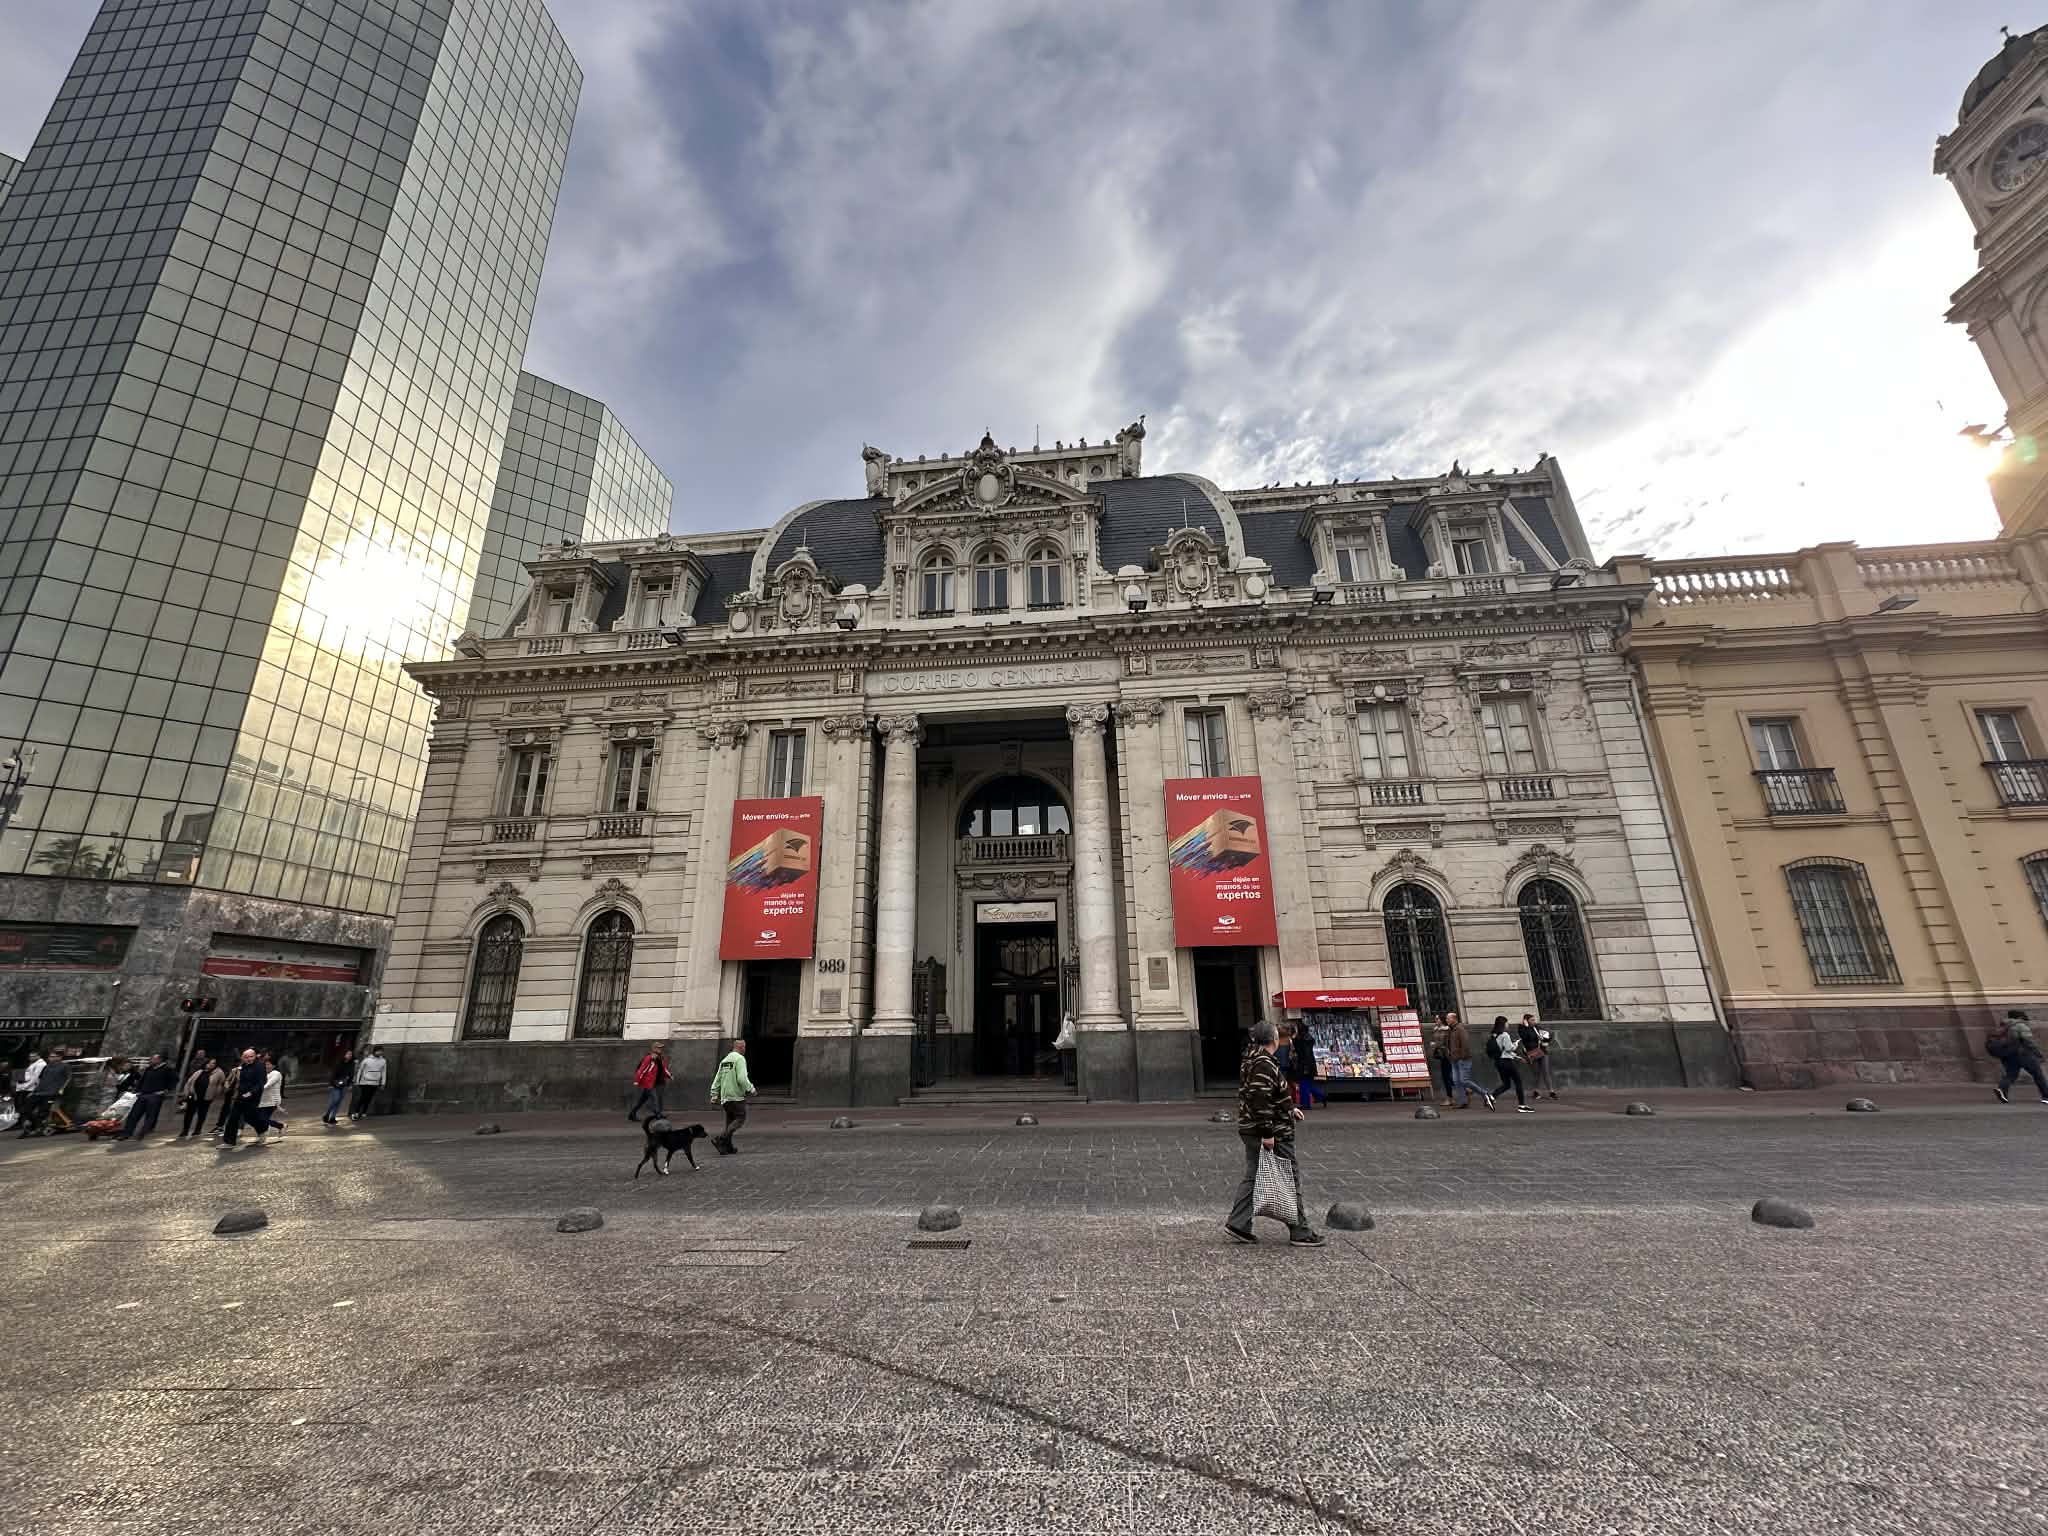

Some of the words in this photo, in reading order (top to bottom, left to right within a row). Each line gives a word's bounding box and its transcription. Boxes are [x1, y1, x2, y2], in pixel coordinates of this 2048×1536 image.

[884, 672, 979, 692] CORREO
[988, 663, 1101, 686] CENTRAL
[1176, 793, 1200, 801] Mover
[742, 813, 765, 821] Mover
[1216, 891, 1261, 902] expertos
[763, 906, 804, 917] expertos
[818, 958, 846, 974] 989
